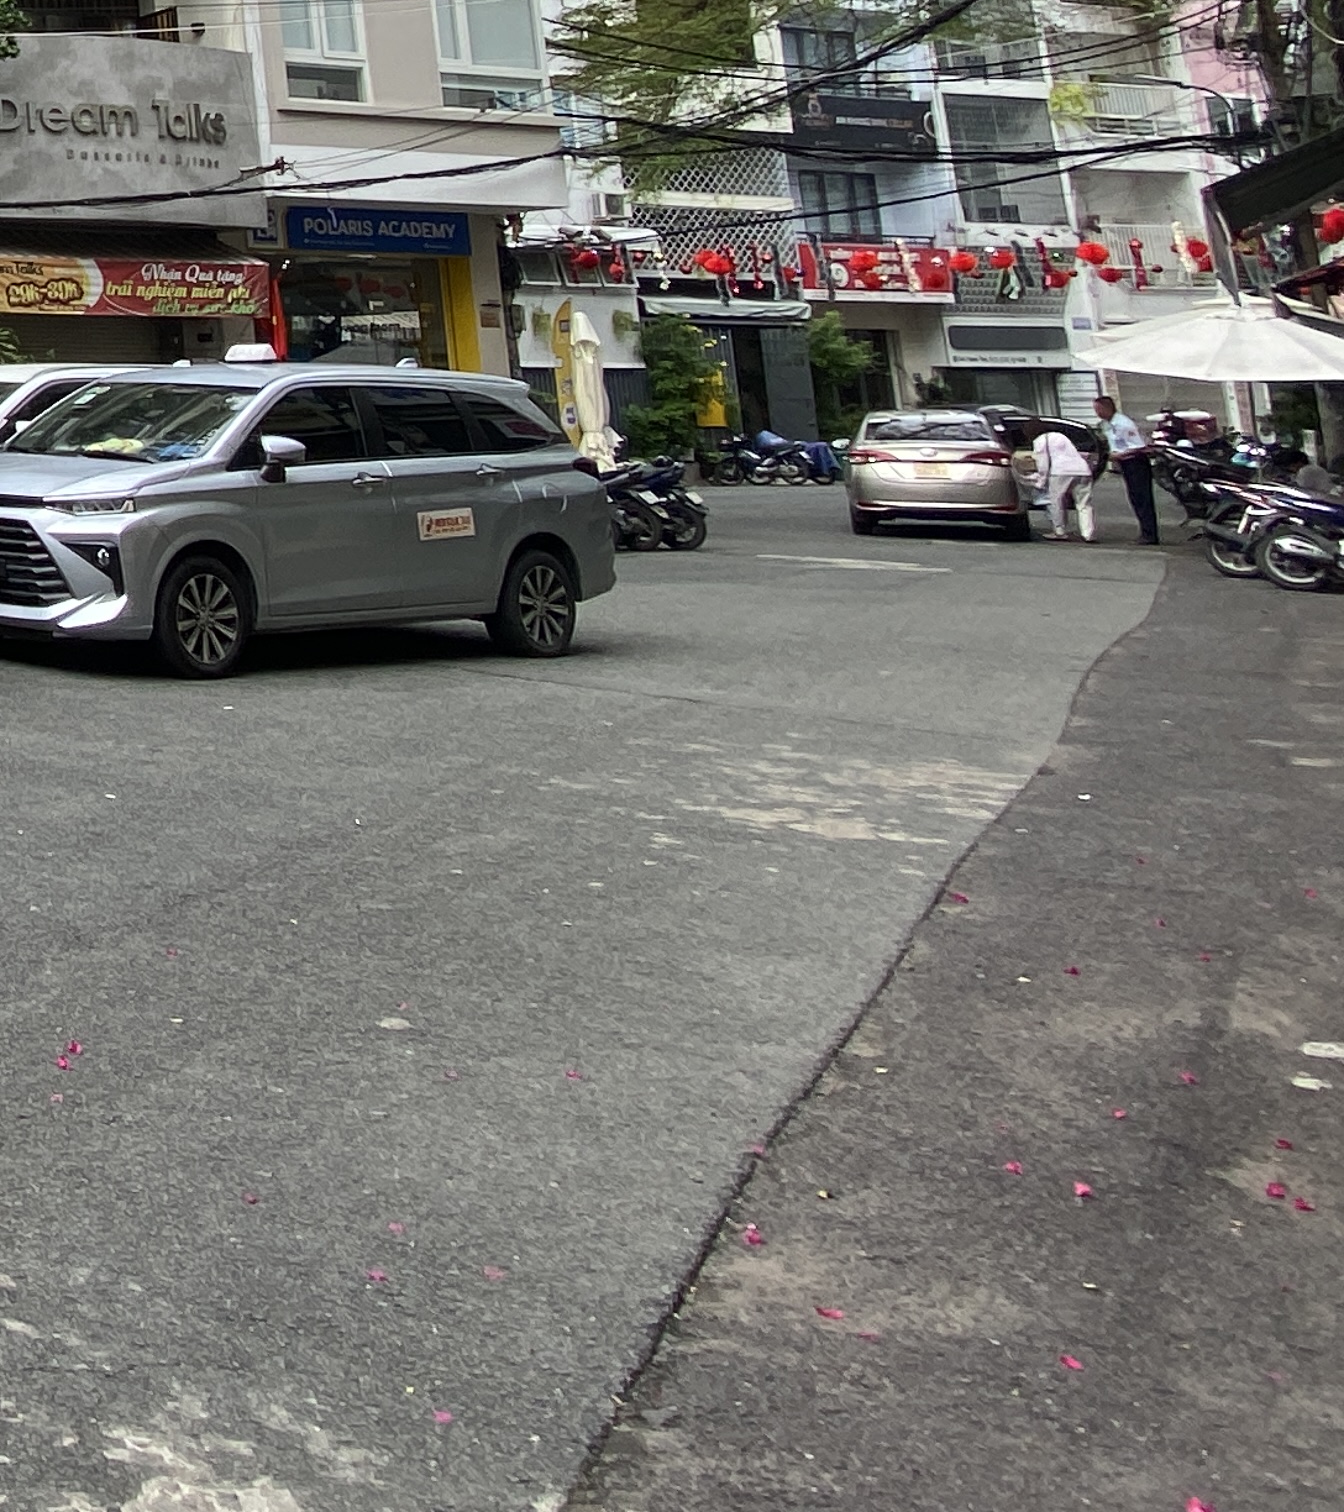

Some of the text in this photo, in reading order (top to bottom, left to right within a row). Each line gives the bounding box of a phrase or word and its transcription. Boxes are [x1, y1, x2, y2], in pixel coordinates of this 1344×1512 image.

[151, 94, 227, 145] Talks
[304, 217, 455, 239] POLARIS ACADEMY
